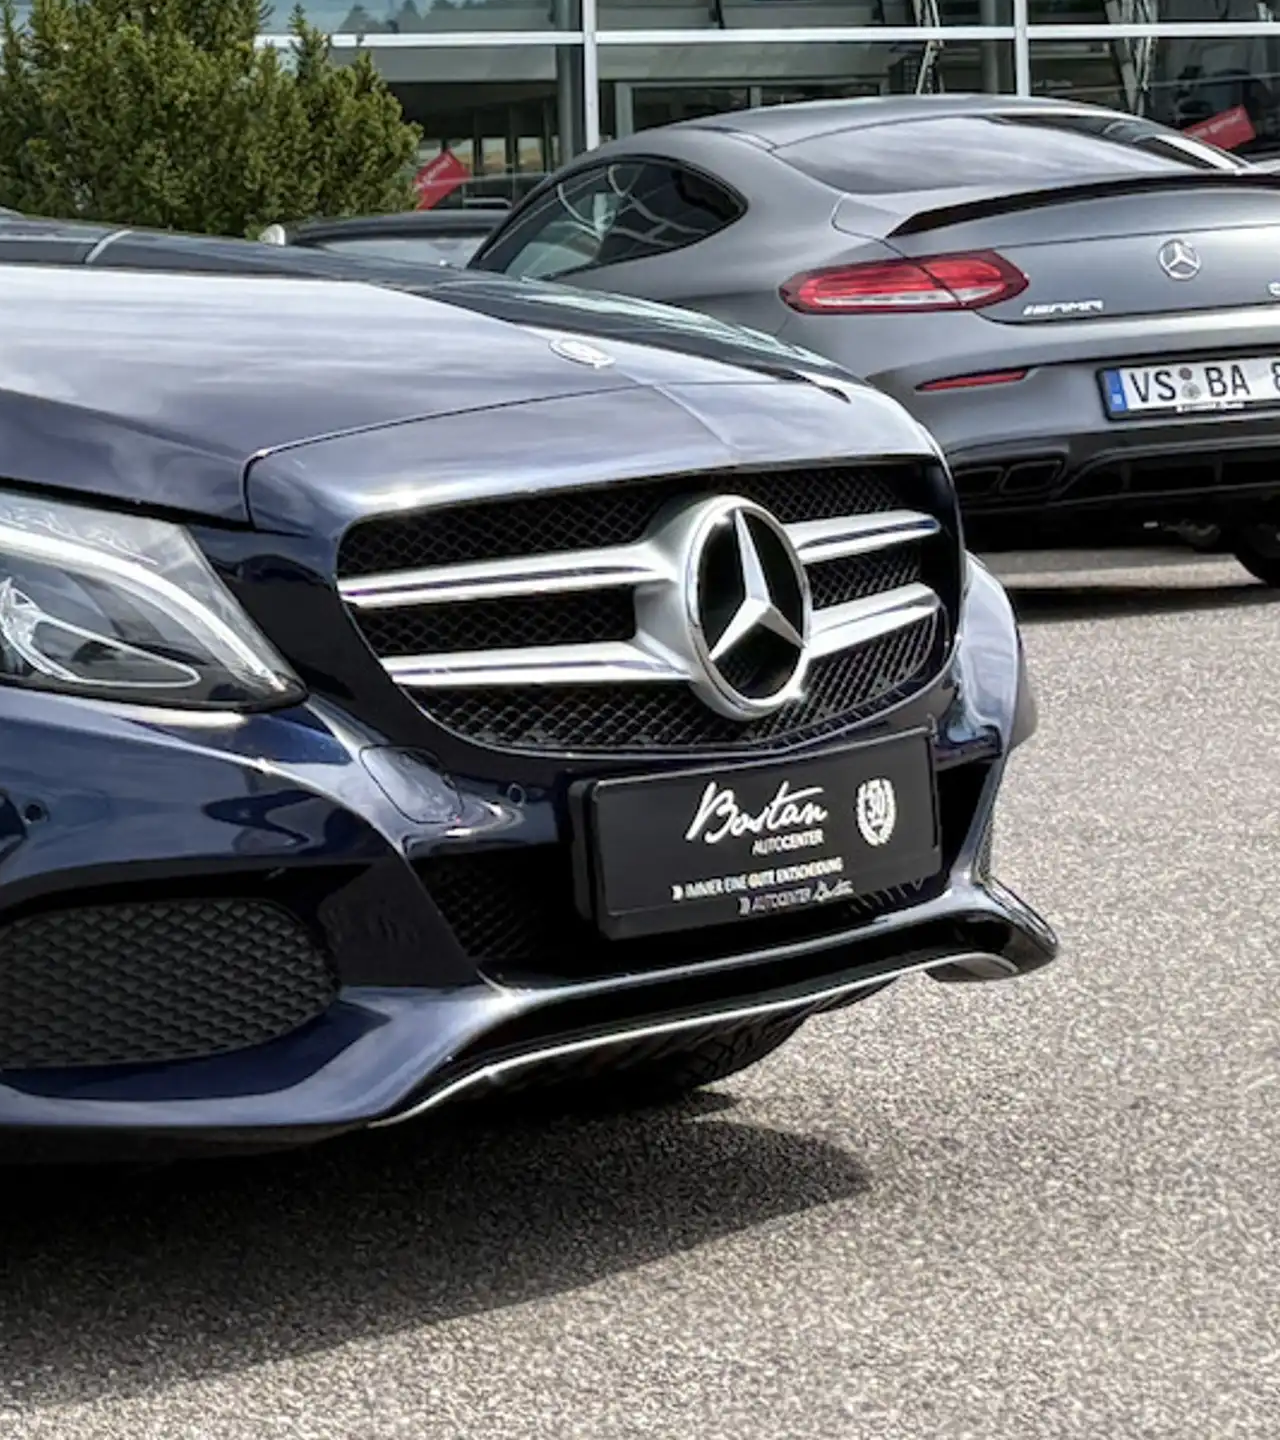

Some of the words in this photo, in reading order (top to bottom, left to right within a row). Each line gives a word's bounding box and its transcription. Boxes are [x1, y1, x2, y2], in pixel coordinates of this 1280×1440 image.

[1129, 370, 1177, 404] VS
[1204, 365, 1250, 397] BA
[685, 781, 828, 844] Bostan
[751, 828, 824, 856] AUTOCENTER
